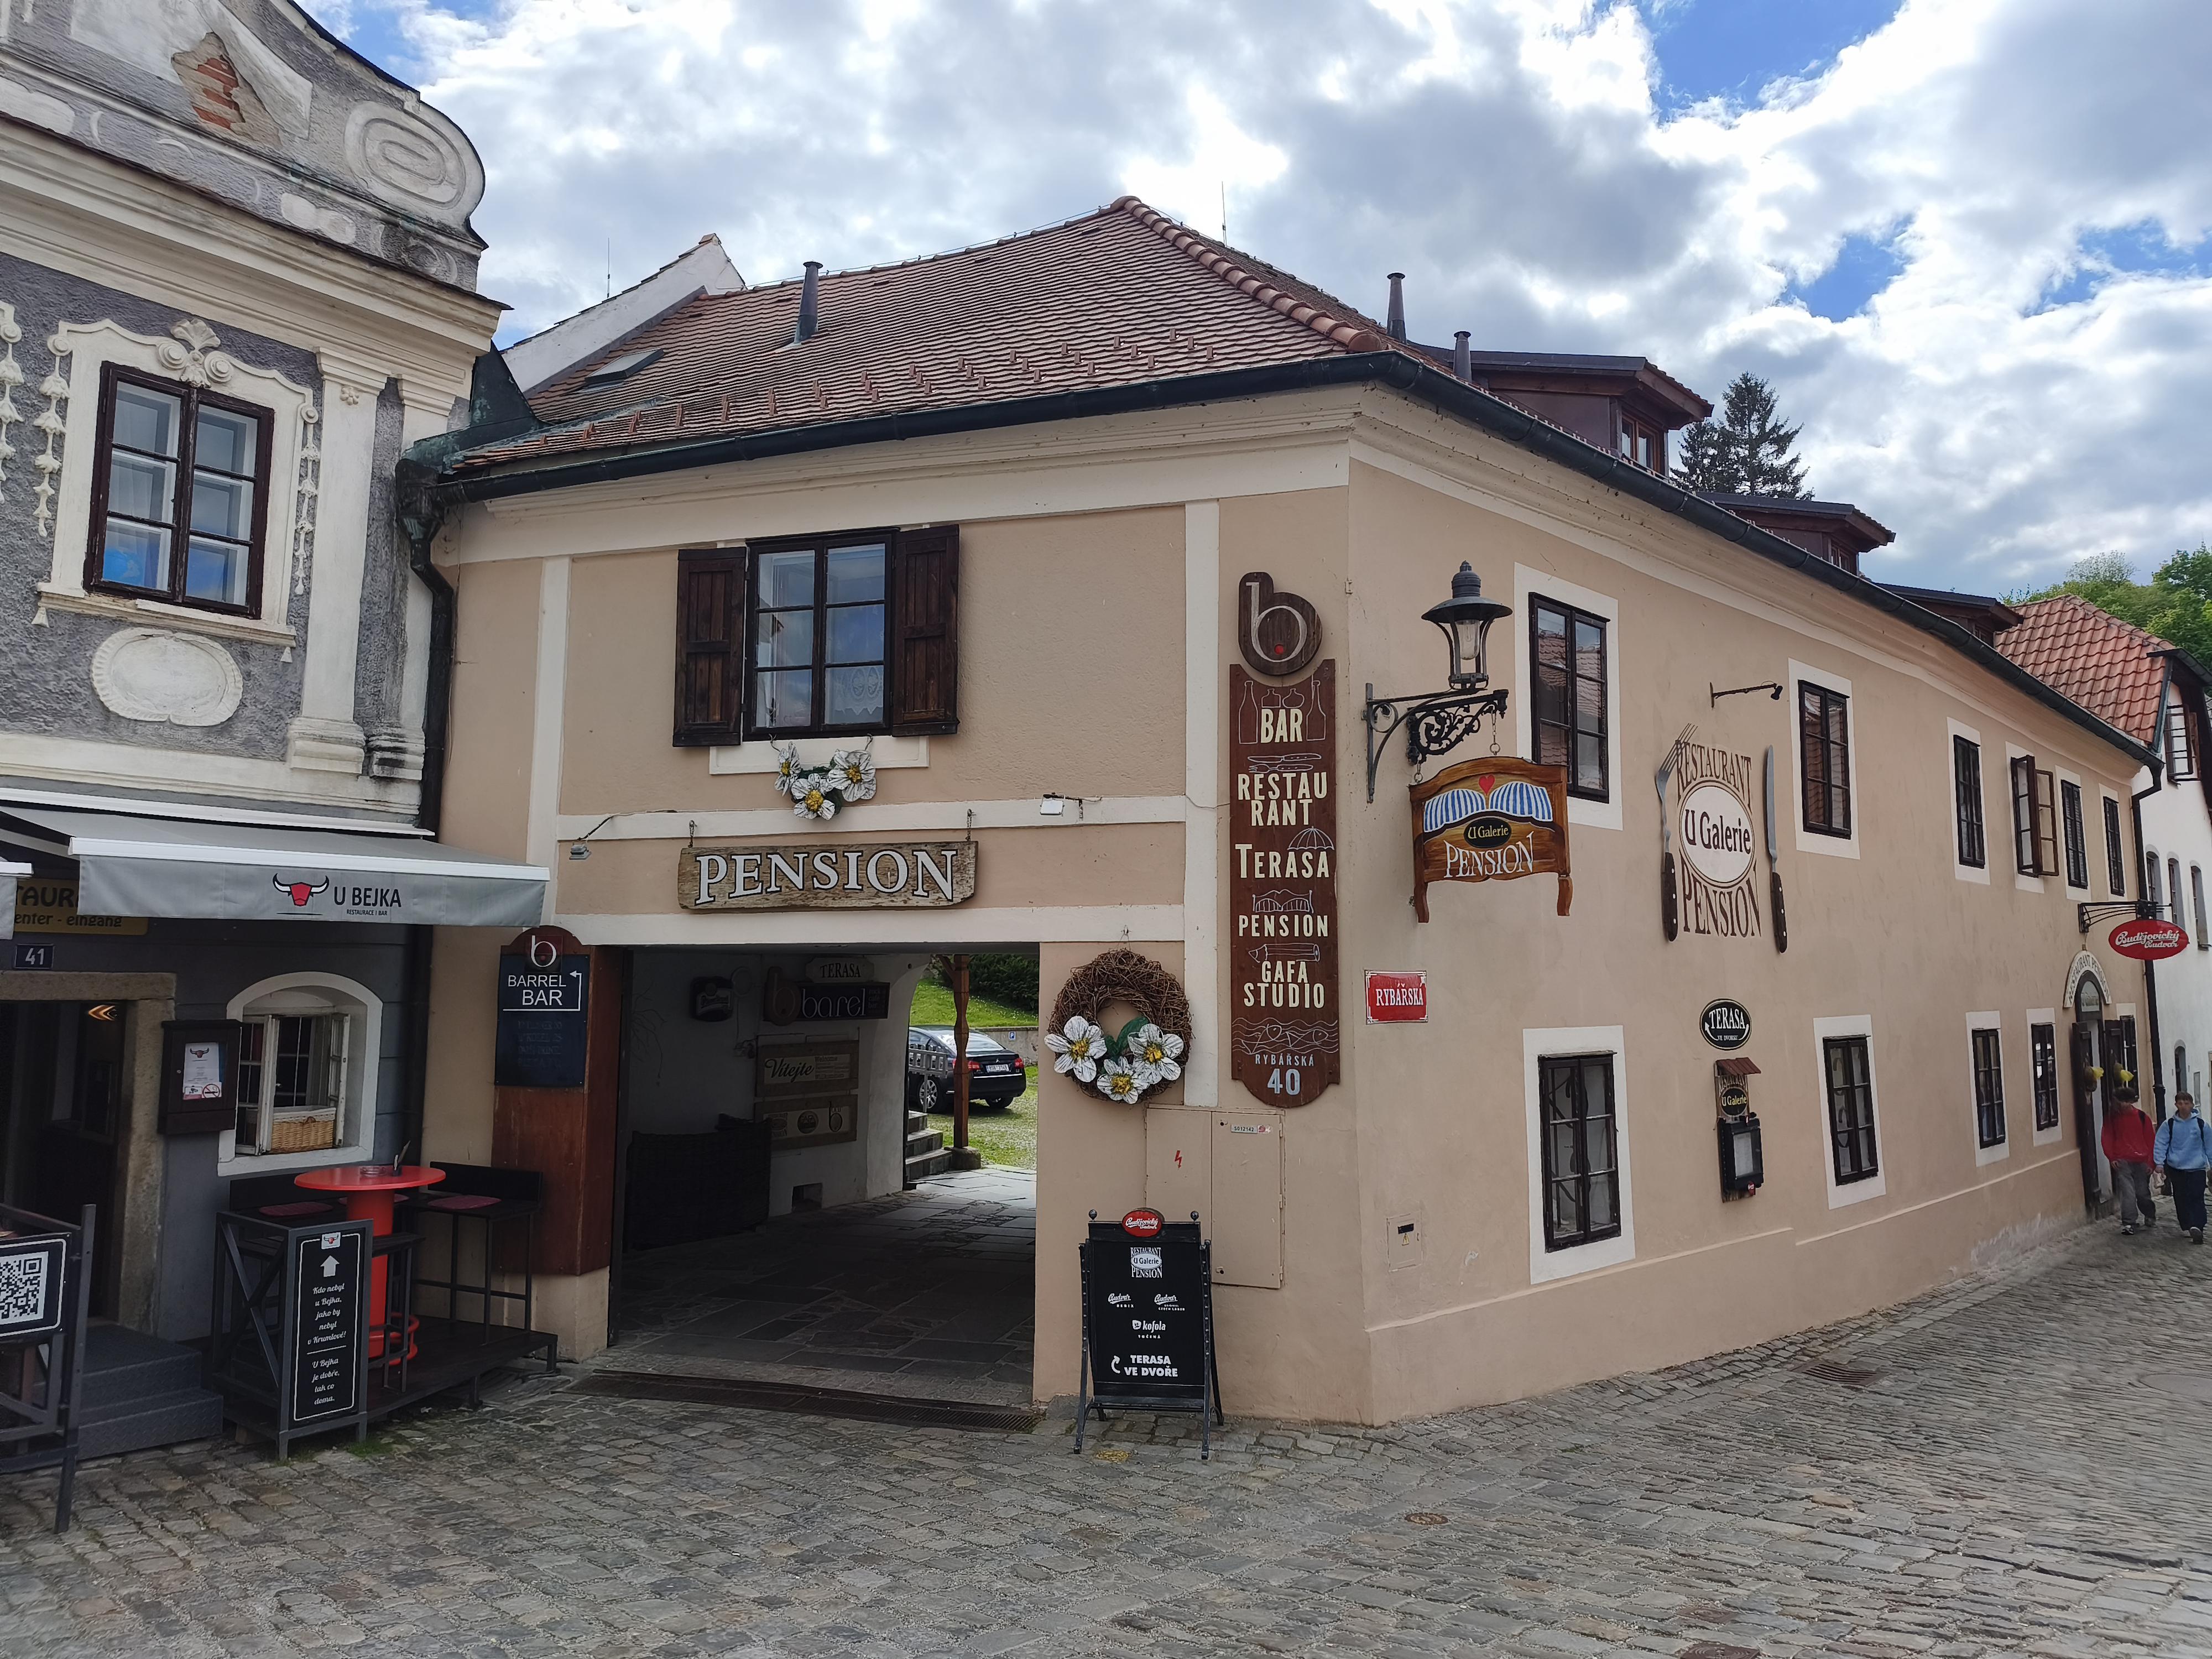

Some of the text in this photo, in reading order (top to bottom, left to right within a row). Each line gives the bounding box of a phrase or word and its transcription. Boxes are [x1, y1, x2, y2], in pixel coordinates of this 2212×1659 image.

[1261, 708, 1302, 743] BAR
[1675, 740, 1752, 815] RESTAURANT
[1238, 772, 1327, 800] RESTAU
[1251, 799, 1312, 826] RANT
[1468, 825, 1509, 839] U Galerie
[1685, 810, 1751, 854] U Galerie
[1443, 831, 1534, 878] PENSION
[695, 849, 958, 906] PENSION
[334, 886, 402, 907] U BEJKA
[1679, 847, 1761, 938] PENSION
[1239, 915, 1328, 937] PENSION
[2115, 930, 2179, 945] Budějovický
[2145, 940, 2179, 948] Budvar
[25, 948, 44, 965] 41
[820, 963, 861, 978] TERASA
[1262, 961, 1308, 983] GAFA
[508, 975, 566, 987] BARREL
[522, 989, 563, 1006] BAR
[1244, 983, 1324, 1008] STUDIO
[1376, 983, 1423, 1006] RYBÁŘSKÁ
[802, 988, 867, 1018] barel
[1709, 1008, 1745, 1029] TERASA
[1255, 1053, 1314, 1066] RYBÁŘSKÁ
[765, 1058, 815, 1083] Vítejte
[1267, 1068, 1301, 1095] 40
[1721, 1094, 1747, 1106] U Galerie
[1130, 1247, 1161, 1259] RESTAURANT
[1130, 1264, 1162, 1278] PENSION
[312, 1283, 345, 1295] Kdo nebyl
[321, 1297, 342, 1306] Bejka,
[1108, 1293, 1131, 1303] Budvar
[1154, 1293, 1178, 1305] Budvar
[315, 1311, 331, 1321] jako
[319, 1321, 337, 1331] nebyl
[1142, 1320, 1166, 1333] kofola
[320, 1358, 338, 1368] Bejka
[1130, 1355, 1171, 1365] TERASA
[311, 1374, 319, 1383] je
[1124, 1365, 1178, 1377] VE DVOŘE
[315, 1385, 326, 1393] tak
